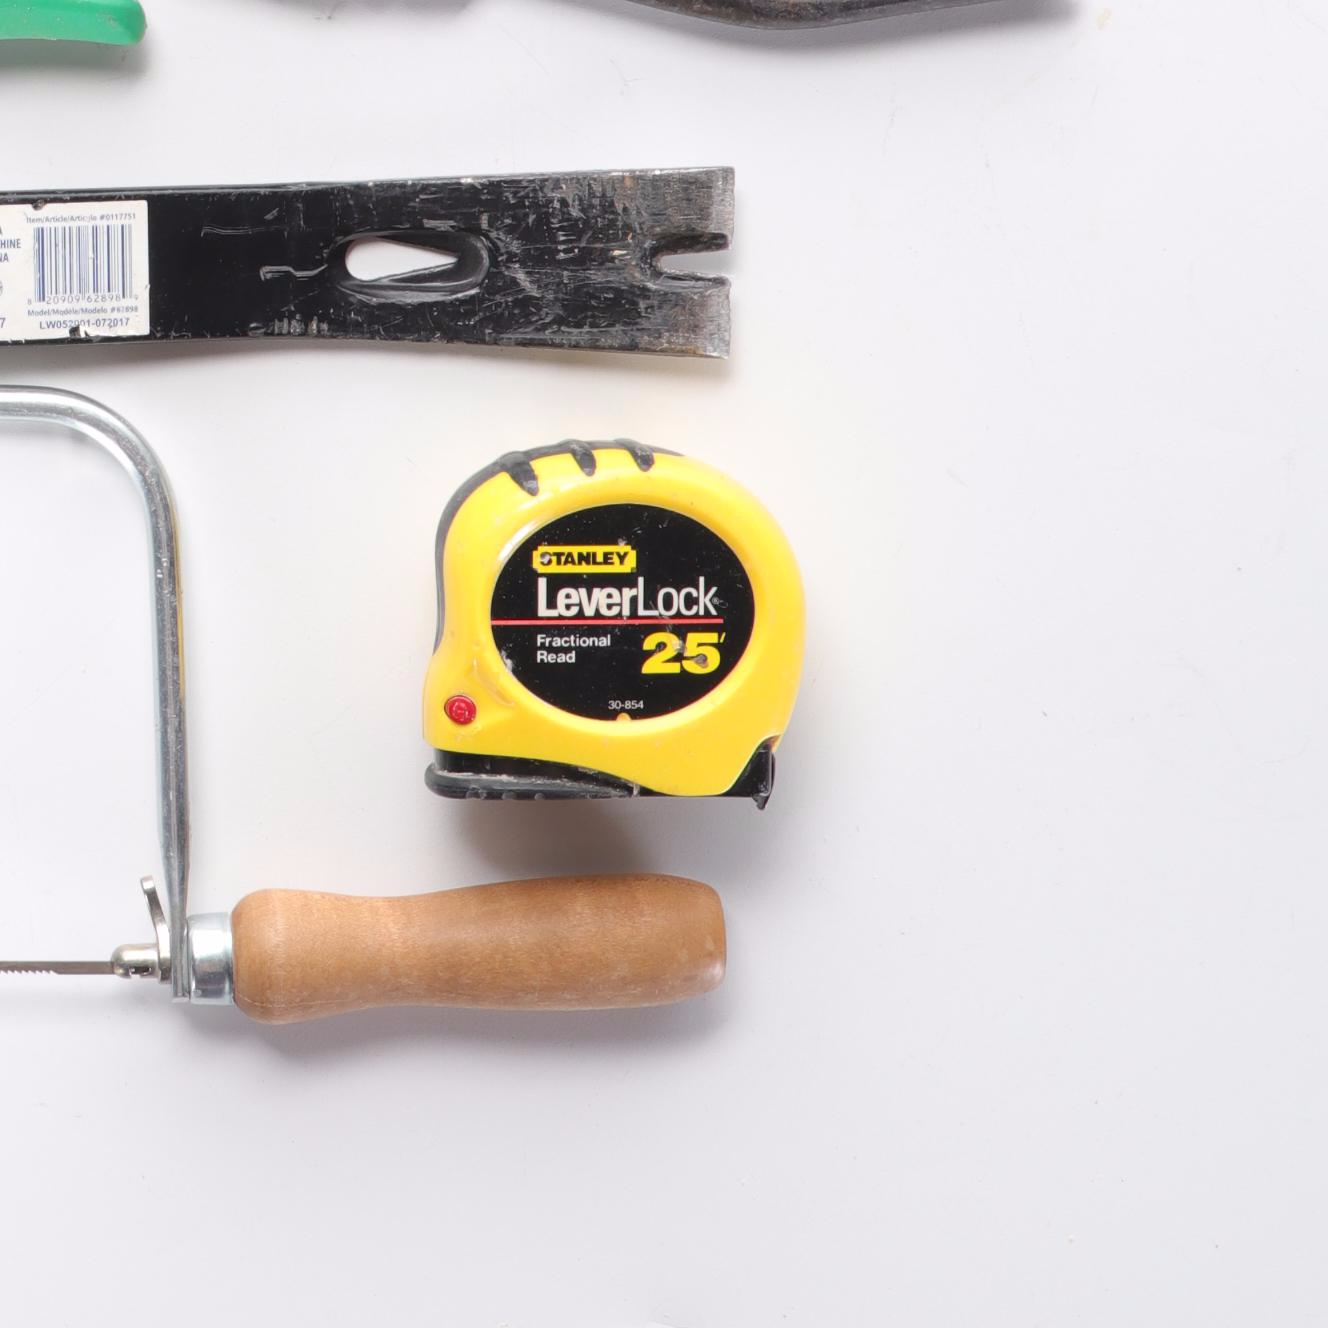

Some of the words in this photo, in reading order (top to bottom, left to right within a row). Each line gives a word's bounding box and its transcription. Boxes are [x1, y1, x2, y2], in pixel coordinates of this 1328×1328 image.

[46, 295, 81, 305] 20909
[87, 294, 121, 303] 62898
[540, 551, 629, 566] STANLEY
[537, 634, 611, 647] Fractional
[537, 651, 576, 664] Read
[608, 700, 644, 710] 30-854
